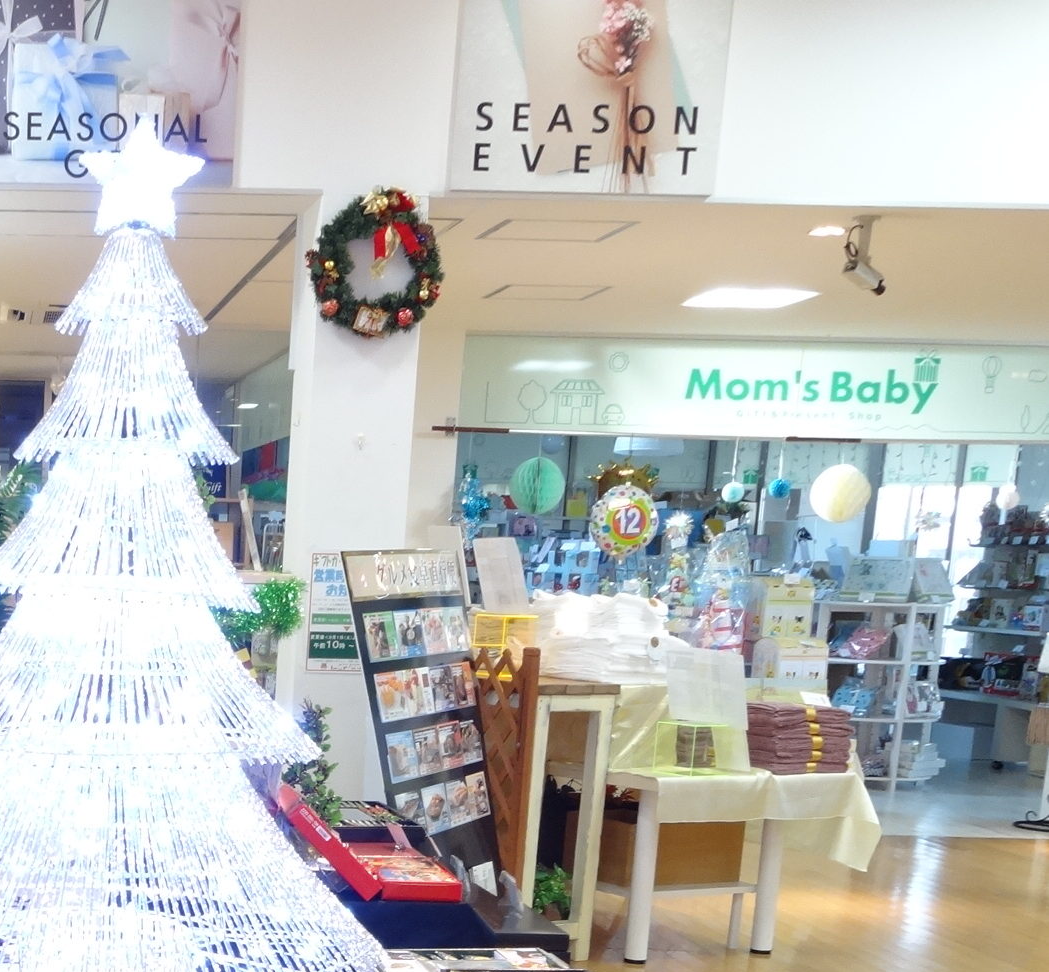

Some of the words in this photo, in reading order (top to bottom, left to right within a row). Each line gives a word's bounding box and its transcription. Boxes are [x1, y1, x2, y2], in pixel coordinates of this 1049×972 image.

[473, 101, 699, 136] SEASON
[473, 142, 698, 176] EVENT
[685, 368, 820, 401] Mom's
[830, 369, 939, 415] Baby
[848, 411, 882, 421] Shop
[614, 507, 641, 535] 12
